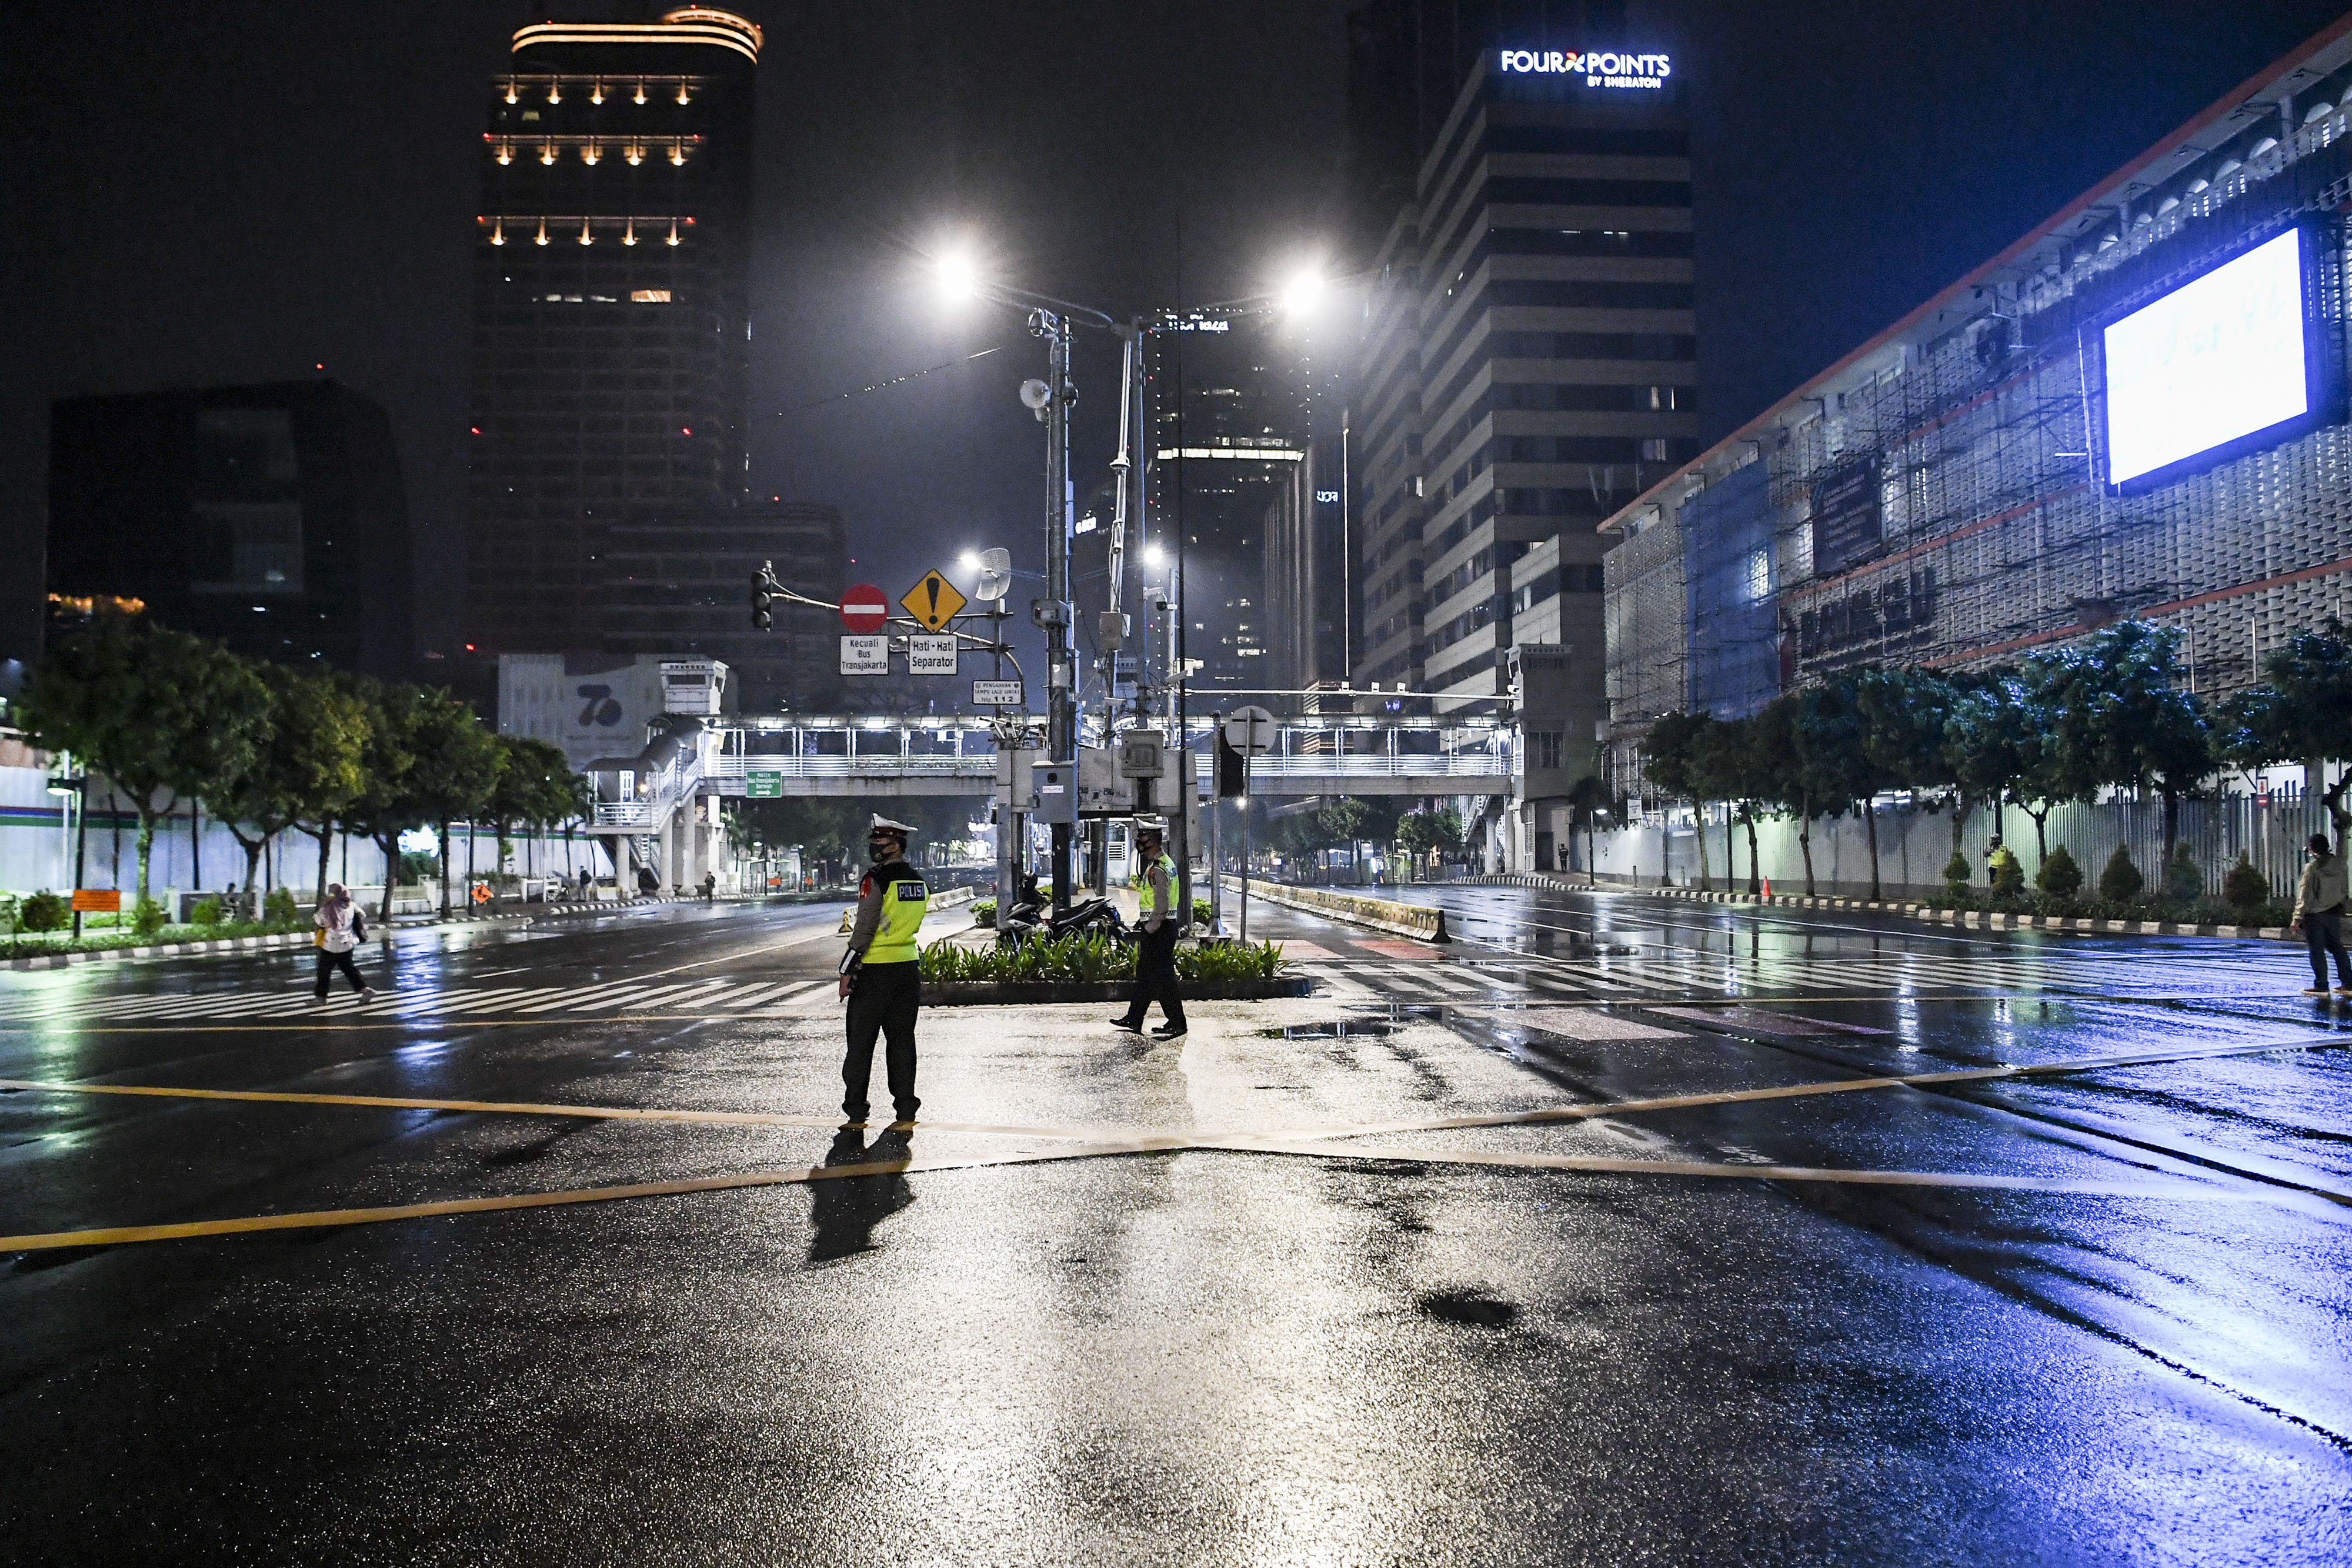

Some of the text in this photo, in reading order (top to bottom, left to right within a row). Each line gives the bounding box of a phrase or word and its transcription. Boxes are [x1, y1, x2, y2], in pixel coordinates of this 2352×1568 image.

[1502, 51, 1670, 76] FOUR POINTS
[1587, 76, 1662, 89] BY SHERATON
[850, 638, 879, 648] Kecuali
[913, 640, 929, 651] Hati
[937, 640, 953, 651] Hati
[858, 650, 871, 658] Bus
[842, 660, 887, 671] Transjakarta
[912, 656, 954, 669] Separator
[899, 885, 925, 898] POLISI
